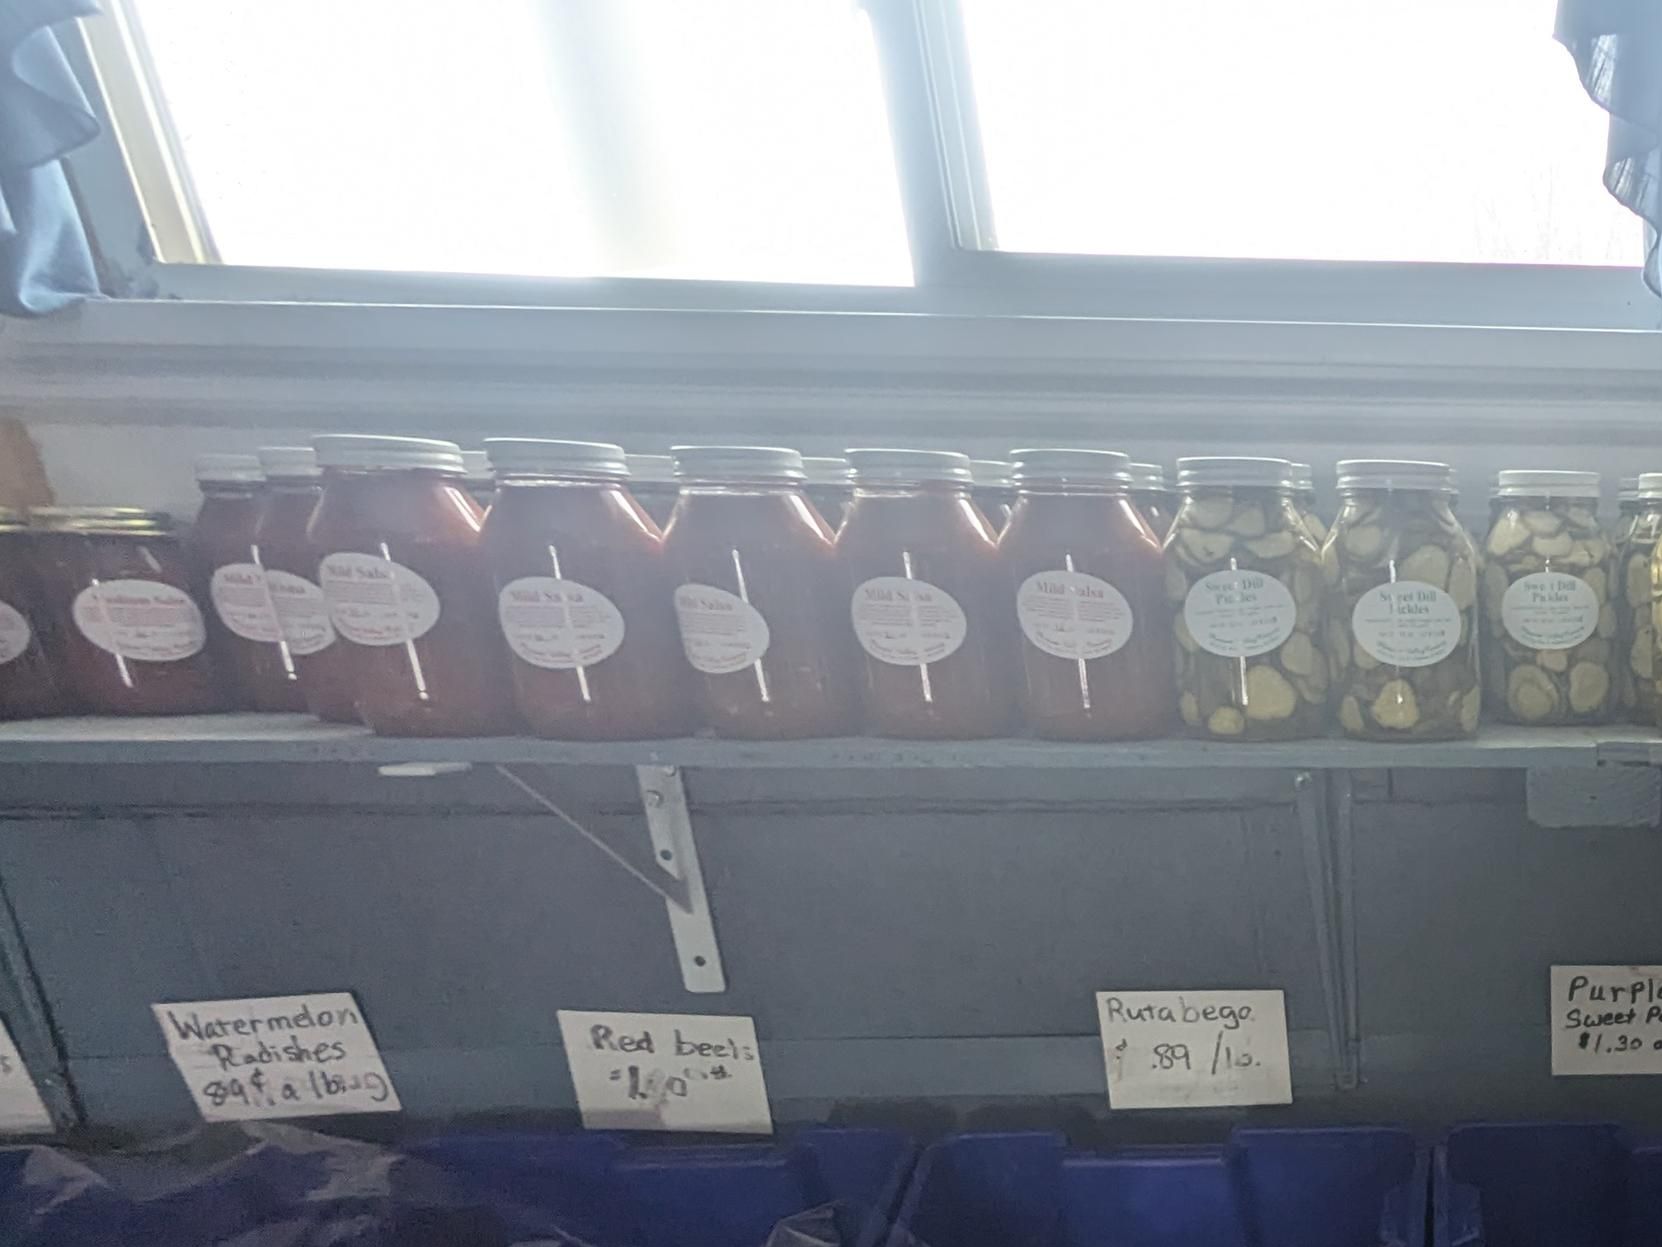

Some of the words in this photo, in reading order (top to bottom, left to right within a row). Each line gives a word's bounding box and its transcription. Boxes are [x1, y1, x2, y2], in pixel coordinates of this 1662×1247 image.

[167, 1003, 359, 1041] Watermelon
[1566, 1007, 1636, 1029] Sweet
[212, 1035, 347, 1071] Radishes
[590, 1024, 655, 1054] Red
[1152, 1043, 1191, 1070] .89
